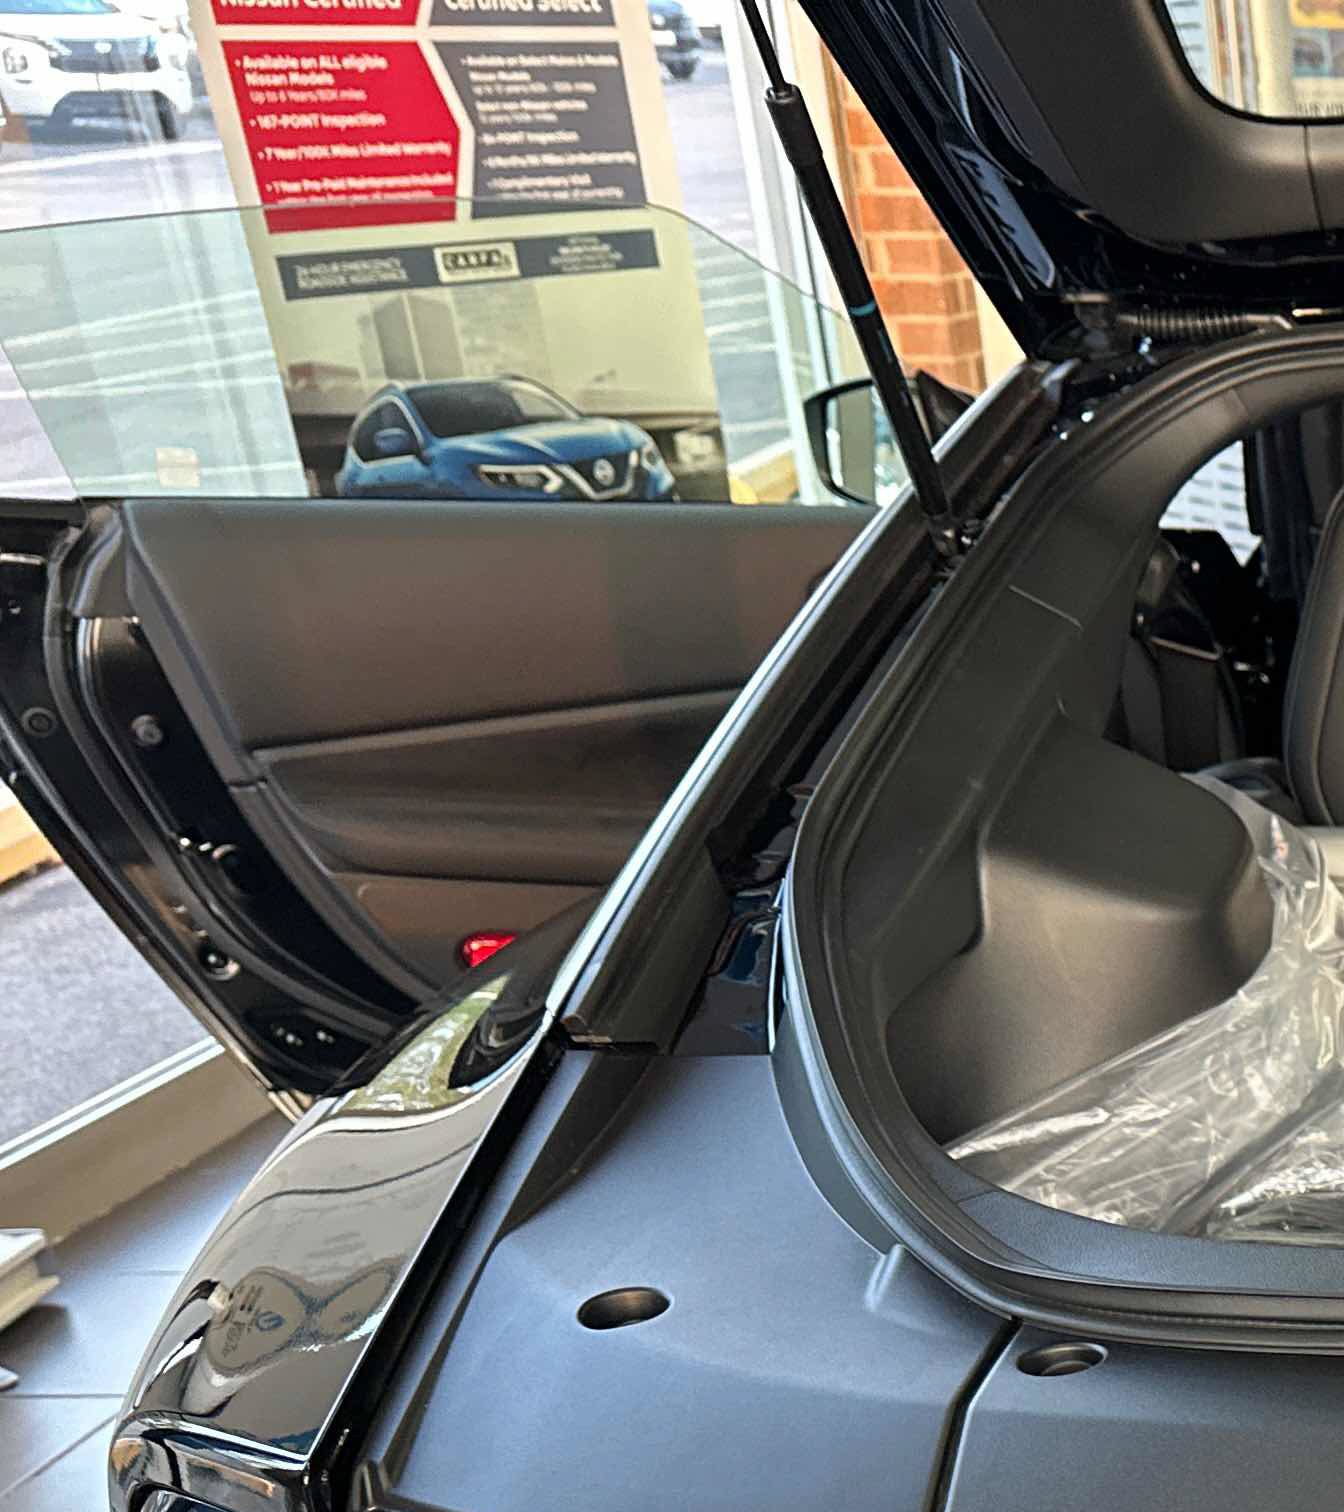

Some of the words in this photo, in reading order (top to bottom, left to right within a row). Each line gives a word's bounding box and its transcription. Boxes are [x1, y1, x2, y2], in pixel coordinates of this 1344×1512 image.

[243, 55, 299, 70] Available
[245, 73, 288, 86] Nissan
[321, 111, 386, 131] Inspection
